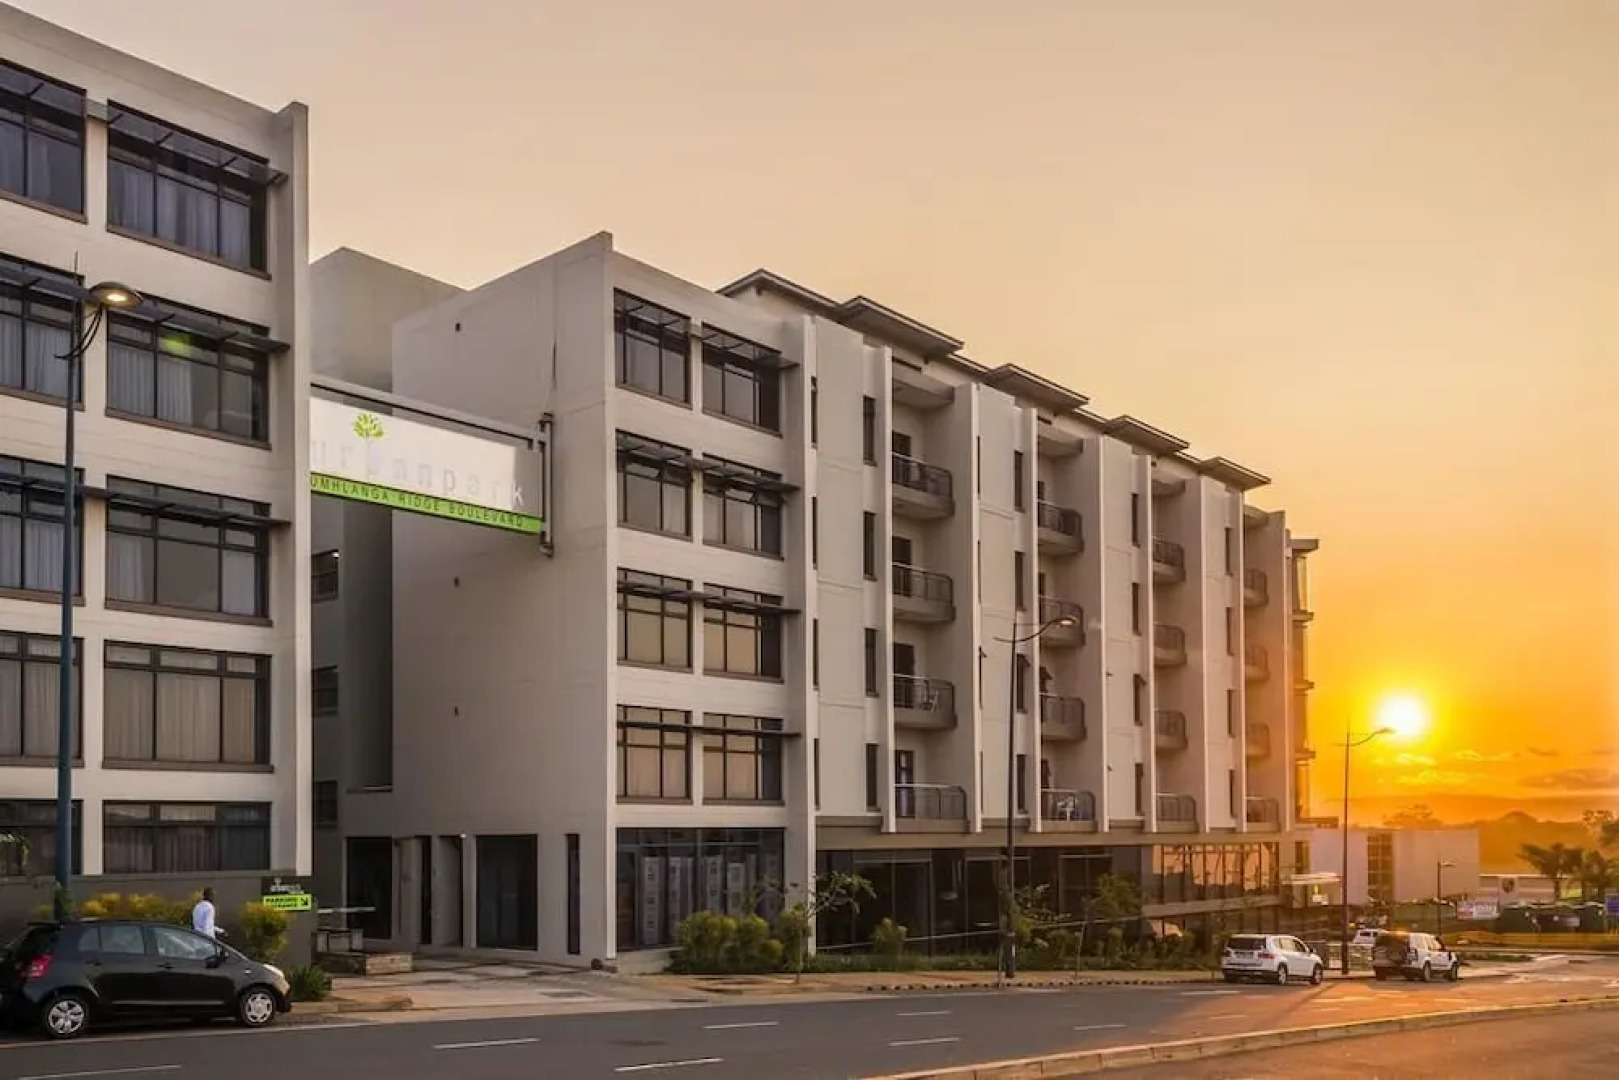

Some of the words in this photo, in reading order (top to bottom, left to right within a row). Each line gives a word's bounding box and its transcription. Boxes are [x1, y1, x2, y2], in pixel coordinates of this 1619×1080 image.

[311, 475, 389, 500] UMHLANGA
[399, 494, 440, 511] RIDGE
[449, 505, 525, 528] BOULEVARD
